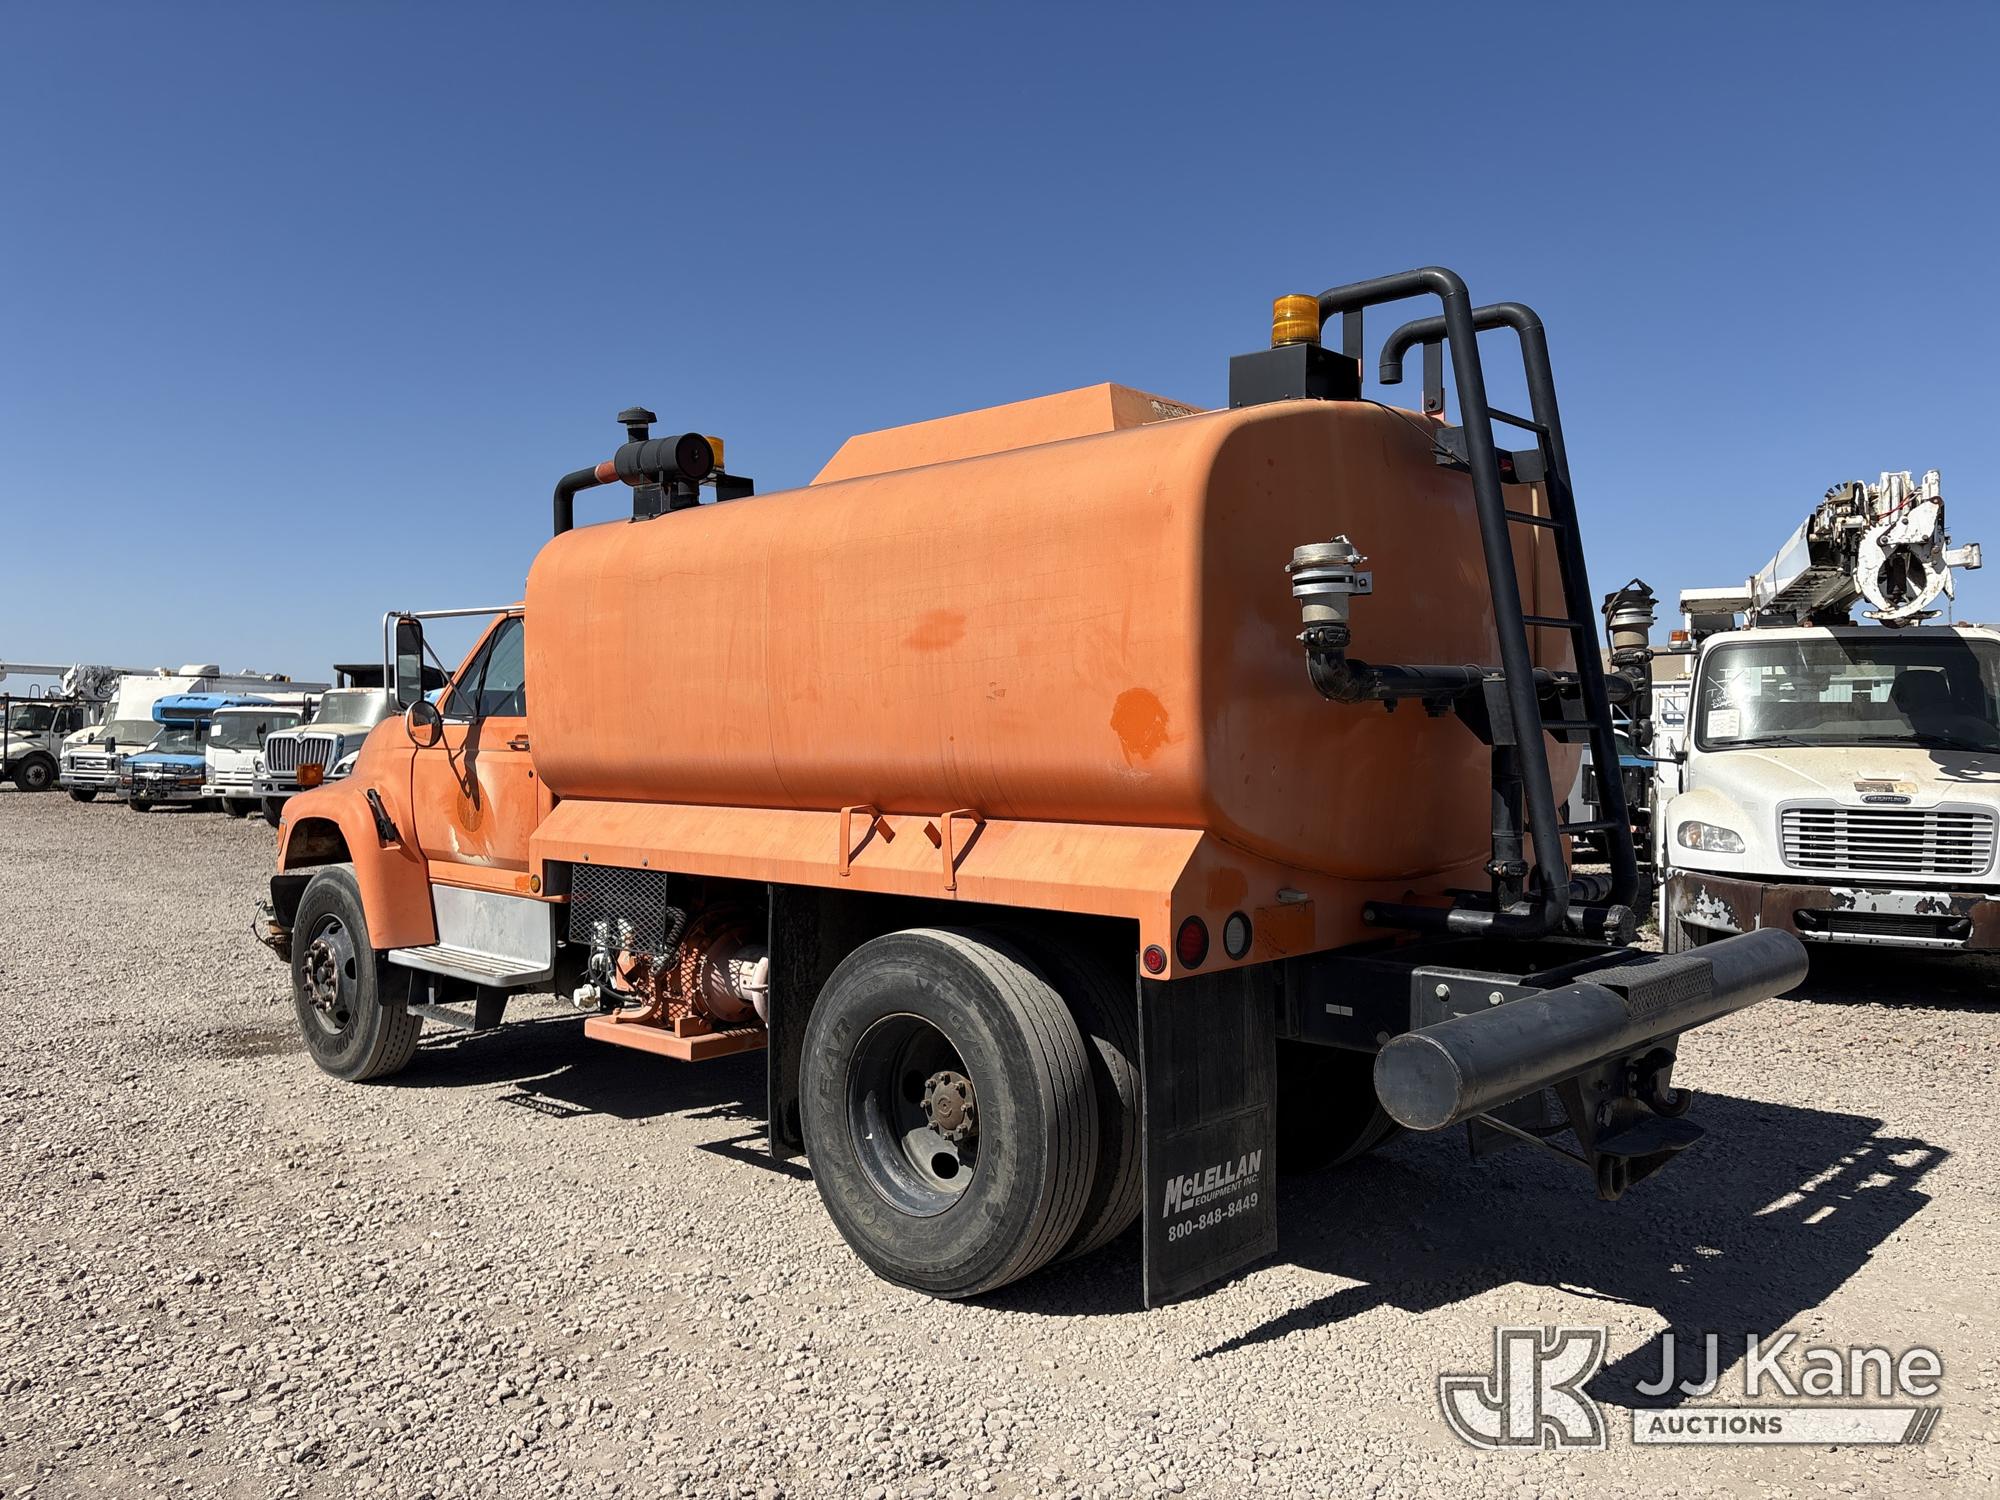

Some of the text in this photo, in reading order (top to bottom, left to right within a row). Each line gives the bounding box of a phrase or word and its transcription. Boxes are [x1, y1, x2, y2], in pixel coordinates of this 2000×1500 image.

[1195, 1173, 1260, 1206] EQUIPMENT INC.
[1168, 1192, 1258, 1242] 800-848-8449
